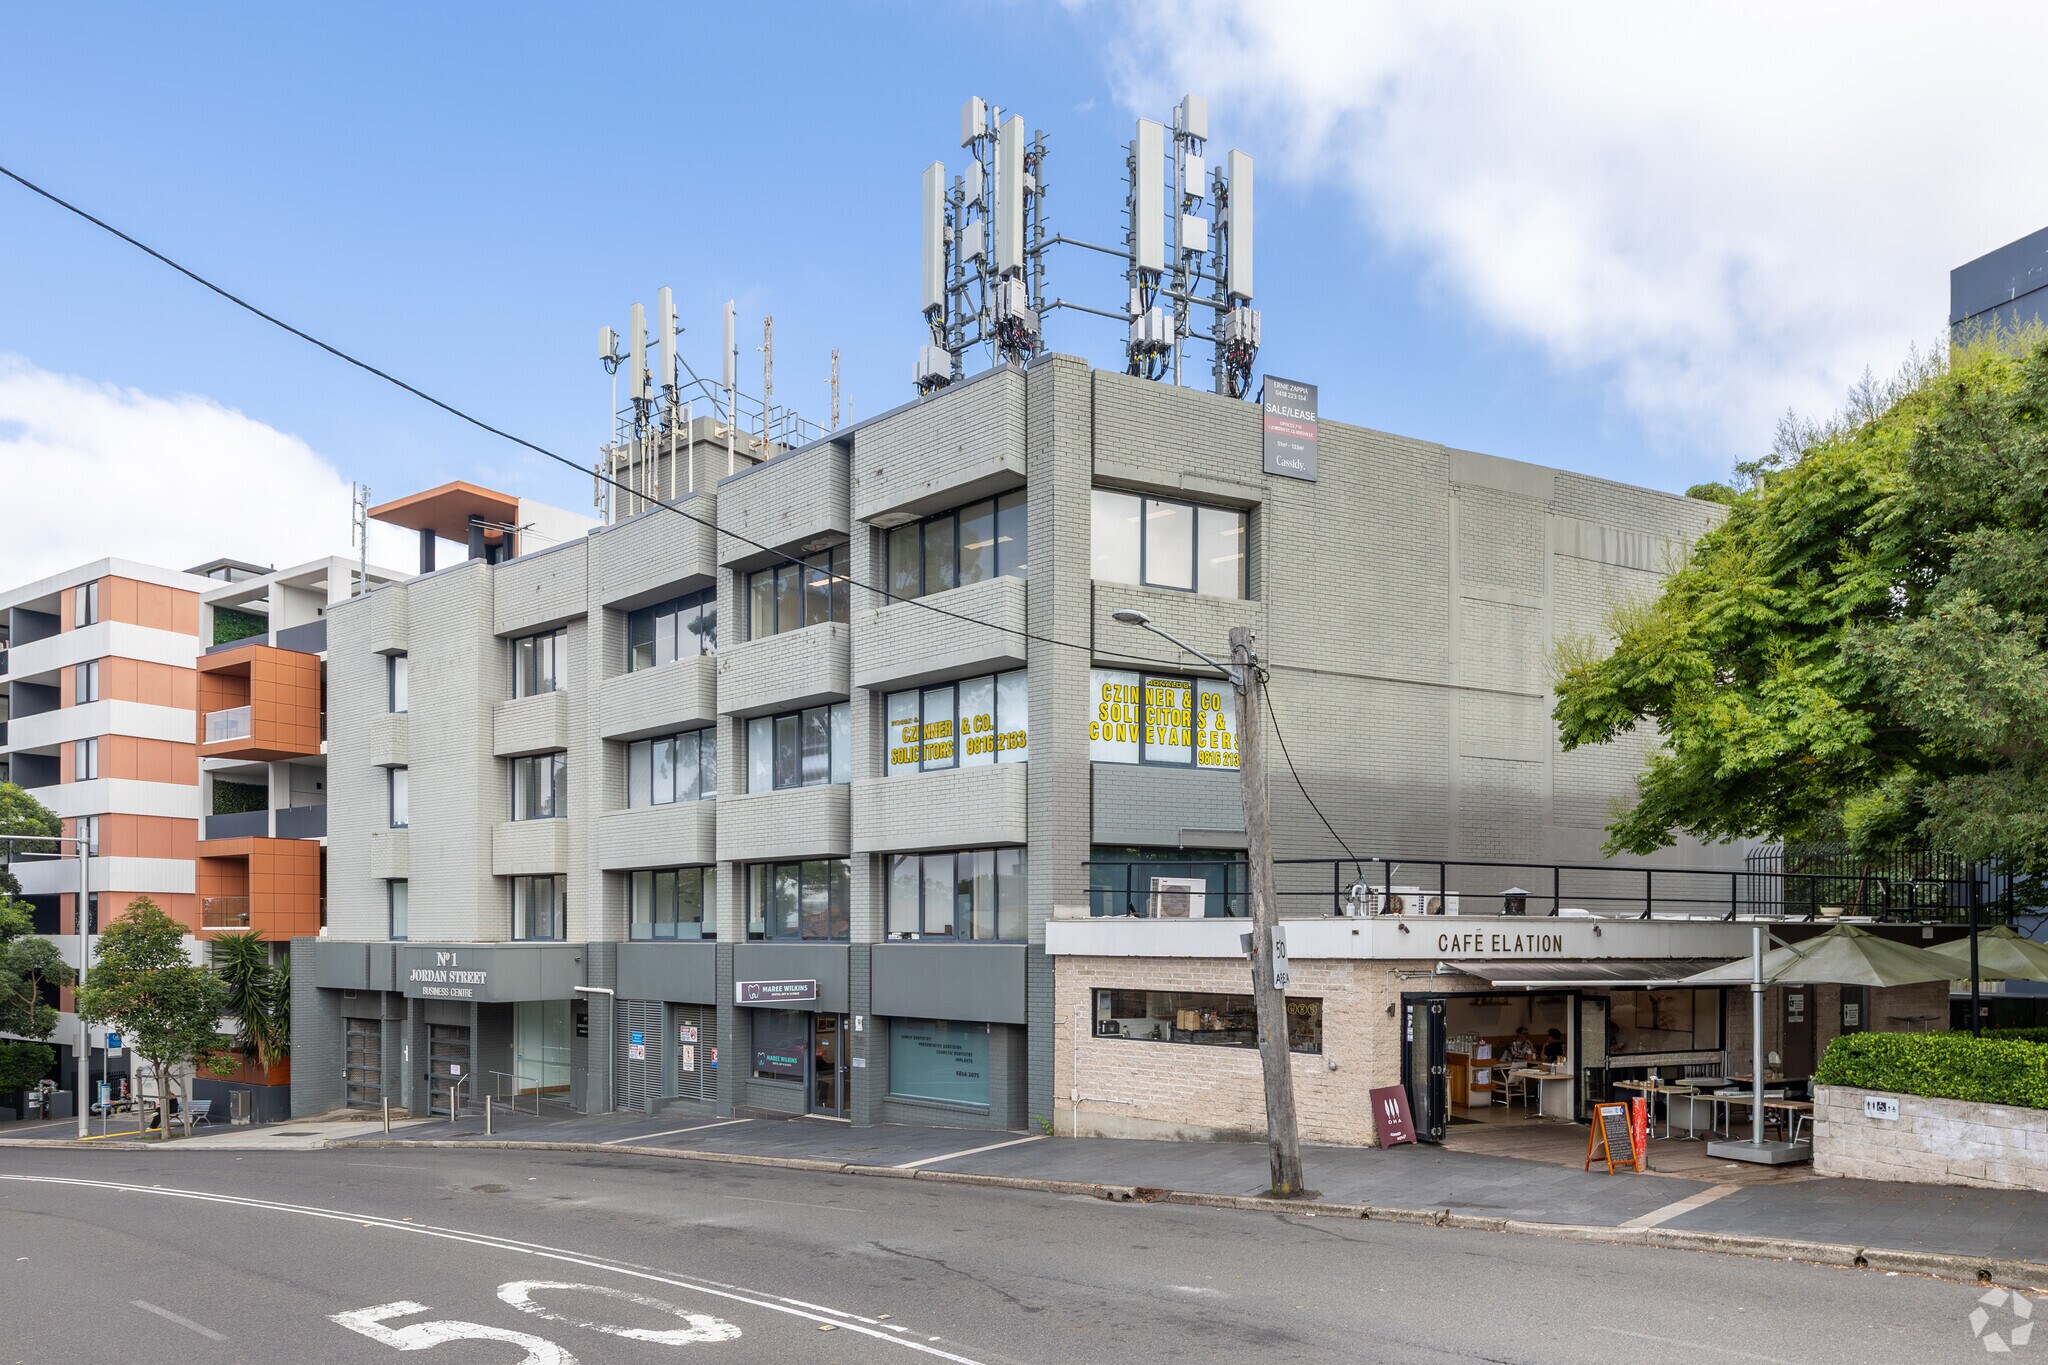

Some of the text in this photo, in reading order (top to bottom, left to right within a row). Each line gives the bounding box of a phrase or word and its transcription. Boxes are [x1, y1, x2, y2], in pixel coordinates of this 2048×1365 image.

[1273, 381, 1289, 390] ERNIE
[1266, 403, 1316, 421] SALE/LEASE
[1102, 683, 1221, 712] CZINNER & CO
[1099, 702, 1226, 731] SOLICITORS &
[901, 713, 994, 743] CZINNER & CO.
[891, 730, 1027, 765] SOLICITORS 9816 2133
[1198, 750, 1240, 767] 9816 213
[1438, 928, 1562, 952] CAFÉ ELATION
[1276, 940, 1286, 959] 50
[451, 952, 458, 967] 1
[410, 969, 487, 984] JORDAN STREET
[422, 986, 473, 998] BUSINESS CENTRE
[762, 984, 808, 993] MAREE WILKINS
[325, 1279, 743, 1365] 50
